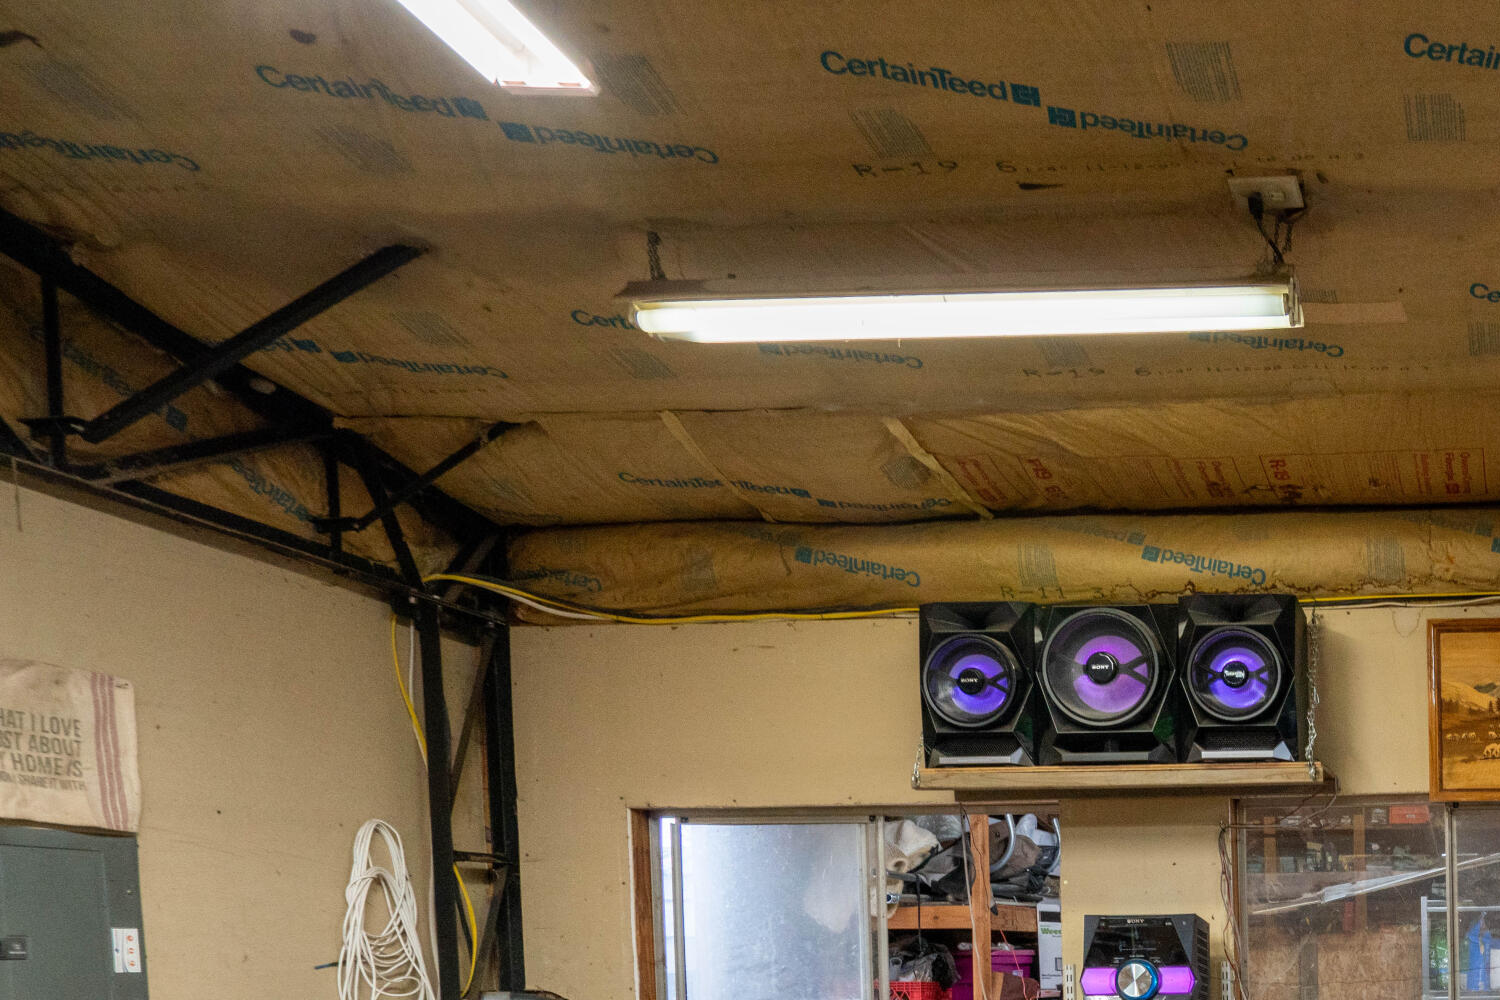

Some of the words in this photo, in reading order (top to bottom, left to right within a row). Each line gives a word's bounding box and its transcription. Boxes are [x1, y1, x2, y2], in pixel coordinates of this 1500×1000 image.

[255, 64, 452, 119] CertainTeed
[819, 50, 1007, 102] CertainTeed
[532, 123, 718, 165] CertainTeed
[1080, 112, 1248, 151] CertainTeed
[1211, 331, 1344, 358] CertainTeed
[810, 547, 921, 588] CertainTeed
[1160, 547, 1267, 586] CertainTeed
[29, 734, 83, 757] ABOUT
[41, 715, 81, 738] LOVE
[10, 753, 63, 776] HOME
